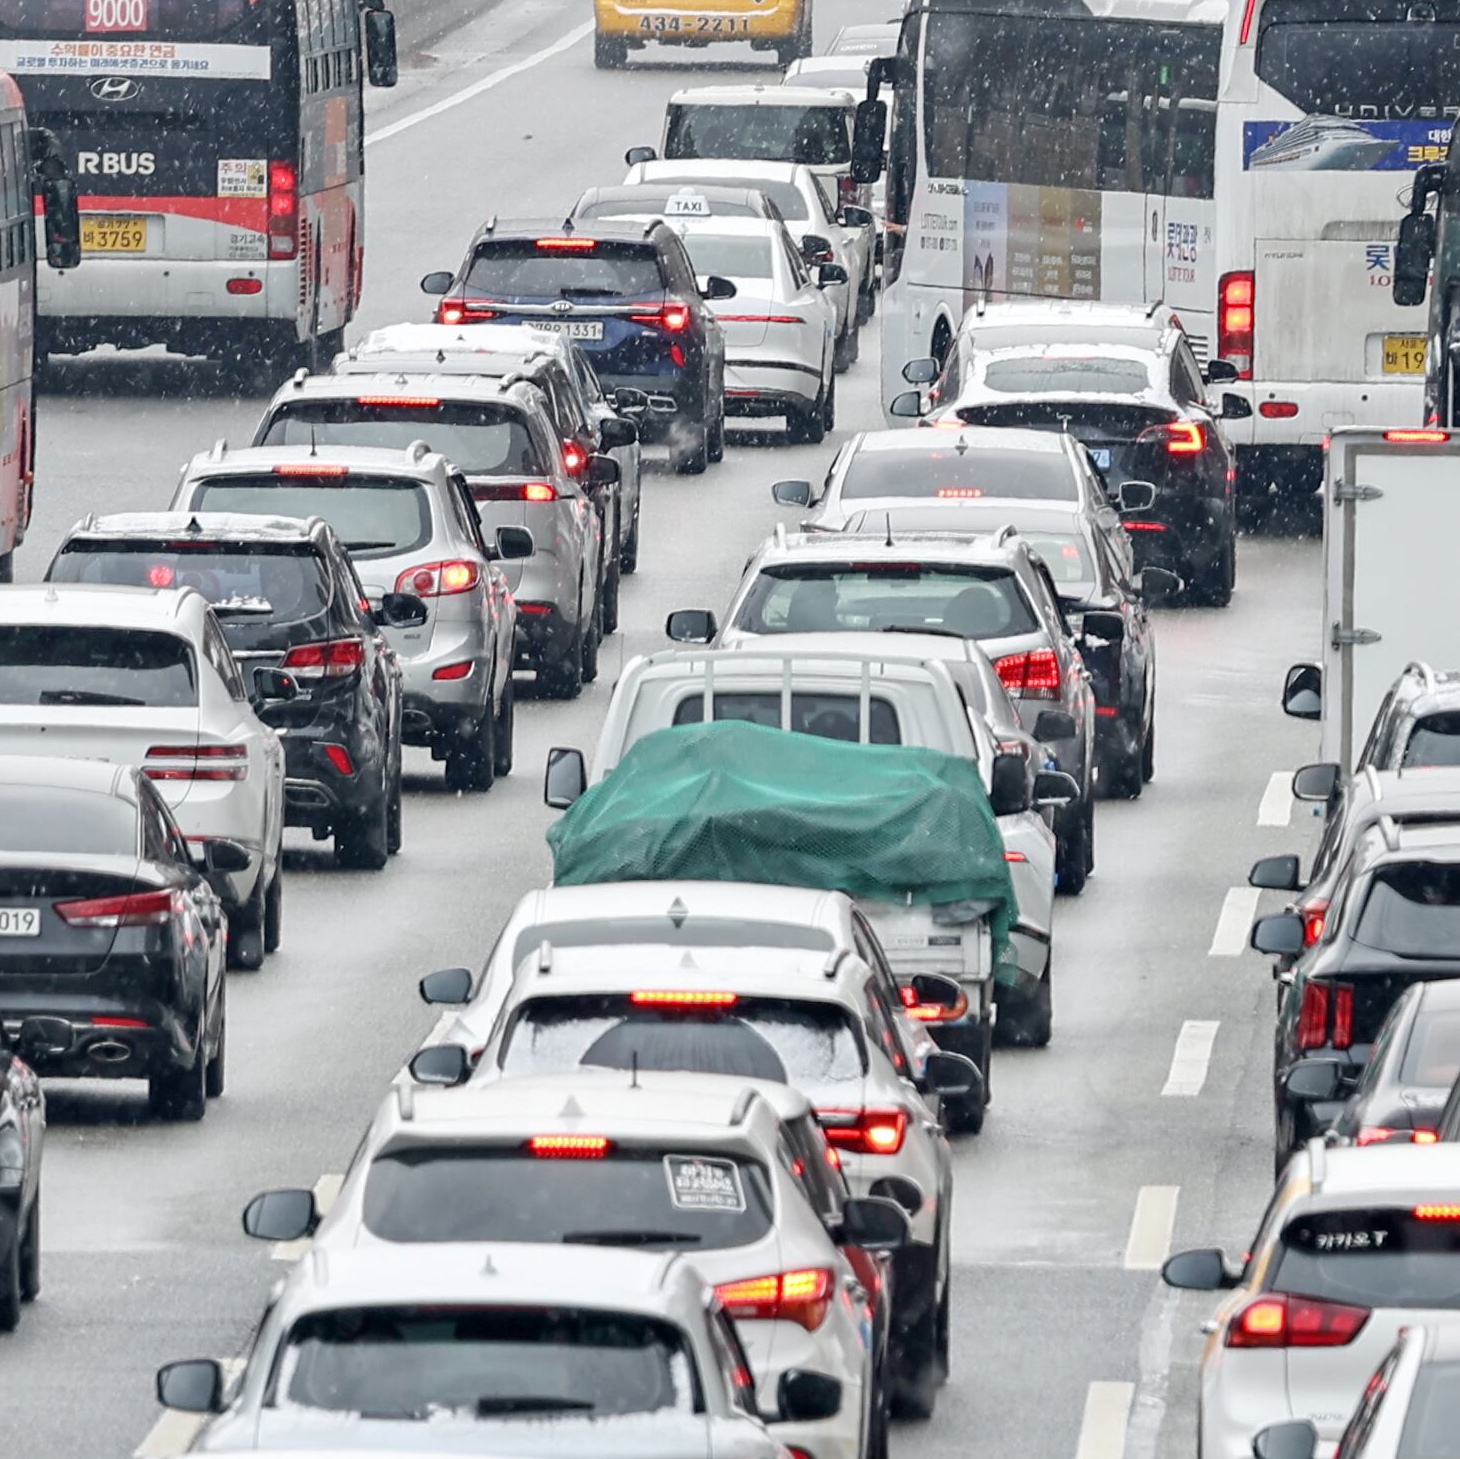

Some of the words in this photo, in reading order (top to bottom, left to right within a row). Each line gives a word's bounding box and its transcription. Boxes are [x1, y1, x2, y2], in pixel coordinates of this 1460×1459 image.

[640, 15, 749, 33] 434-2211
[106, 44, 146, 57] 중요한
[149, 45, 176, 58] 연금
[675, 201, 702, 212] TAXI
[97, 231, 143, 249] 3759
[566, 322, 598, 338] 1331
[1315, 1232, 1371, 1250] 카카오
[1372, 1230, 1388, 1246] T
